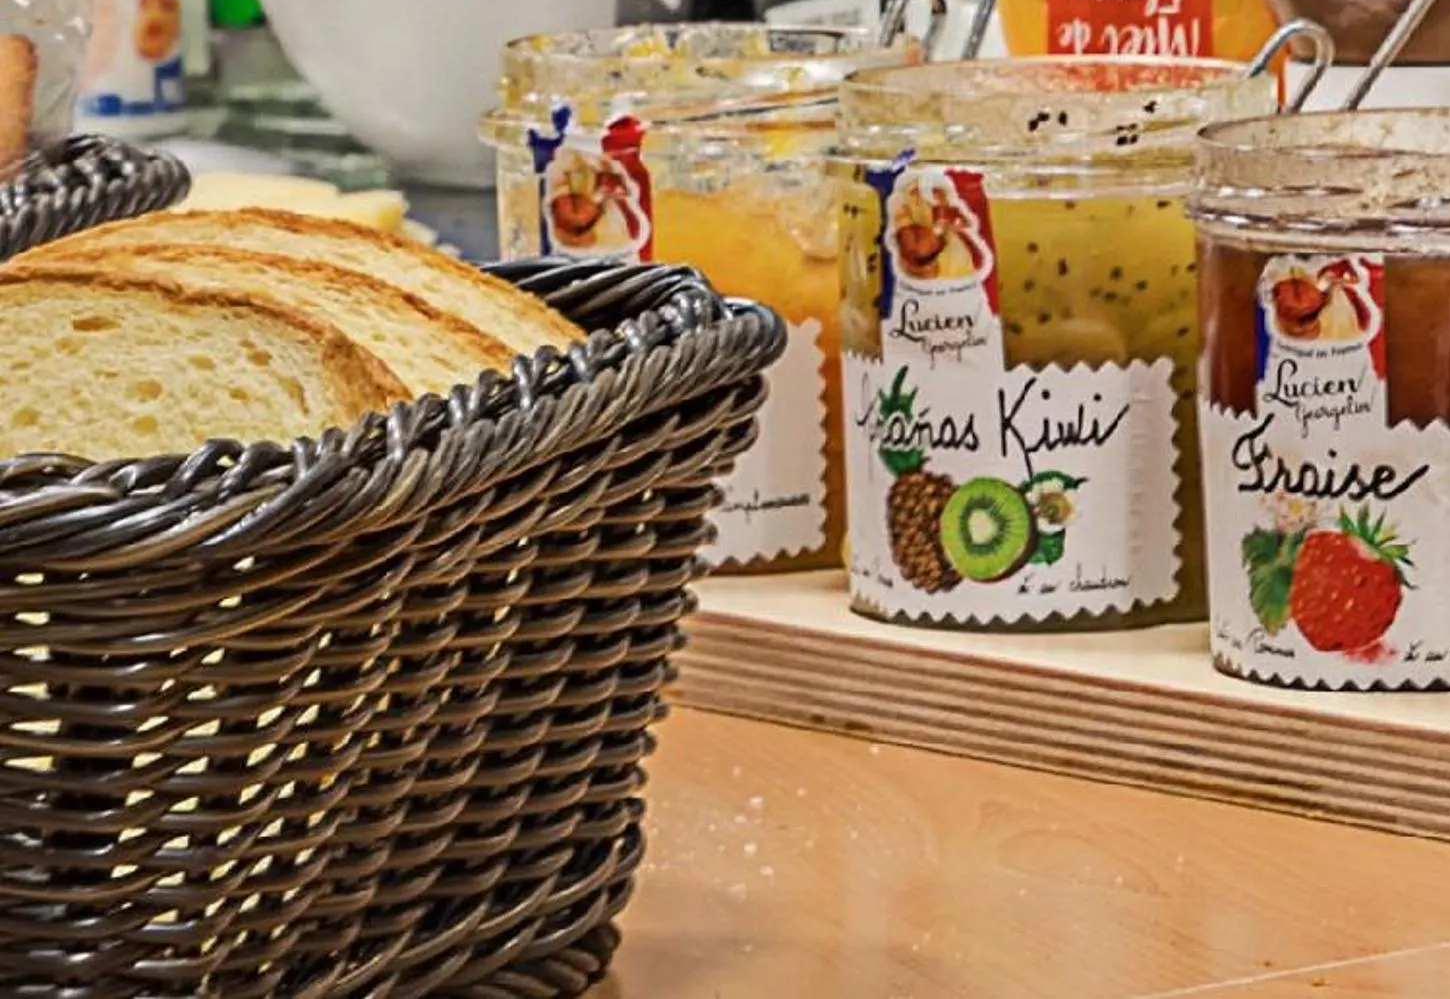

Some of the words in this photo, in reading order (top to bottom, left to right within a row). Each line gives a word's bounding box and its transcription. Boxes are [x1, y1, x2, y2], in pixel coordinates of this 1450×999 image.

[1056, 18, 1093, 57] de
[1098, 18, 1201, 59] Miel
[888, 298, 980, 343] Lucien
[1262, 358, 1367, 407] Lucien
[997, 376, 1131, 480] Kiwi
[1295, 392, 1374, 438] Georgelin
[1230, 413, 1431, 502] Fraise
